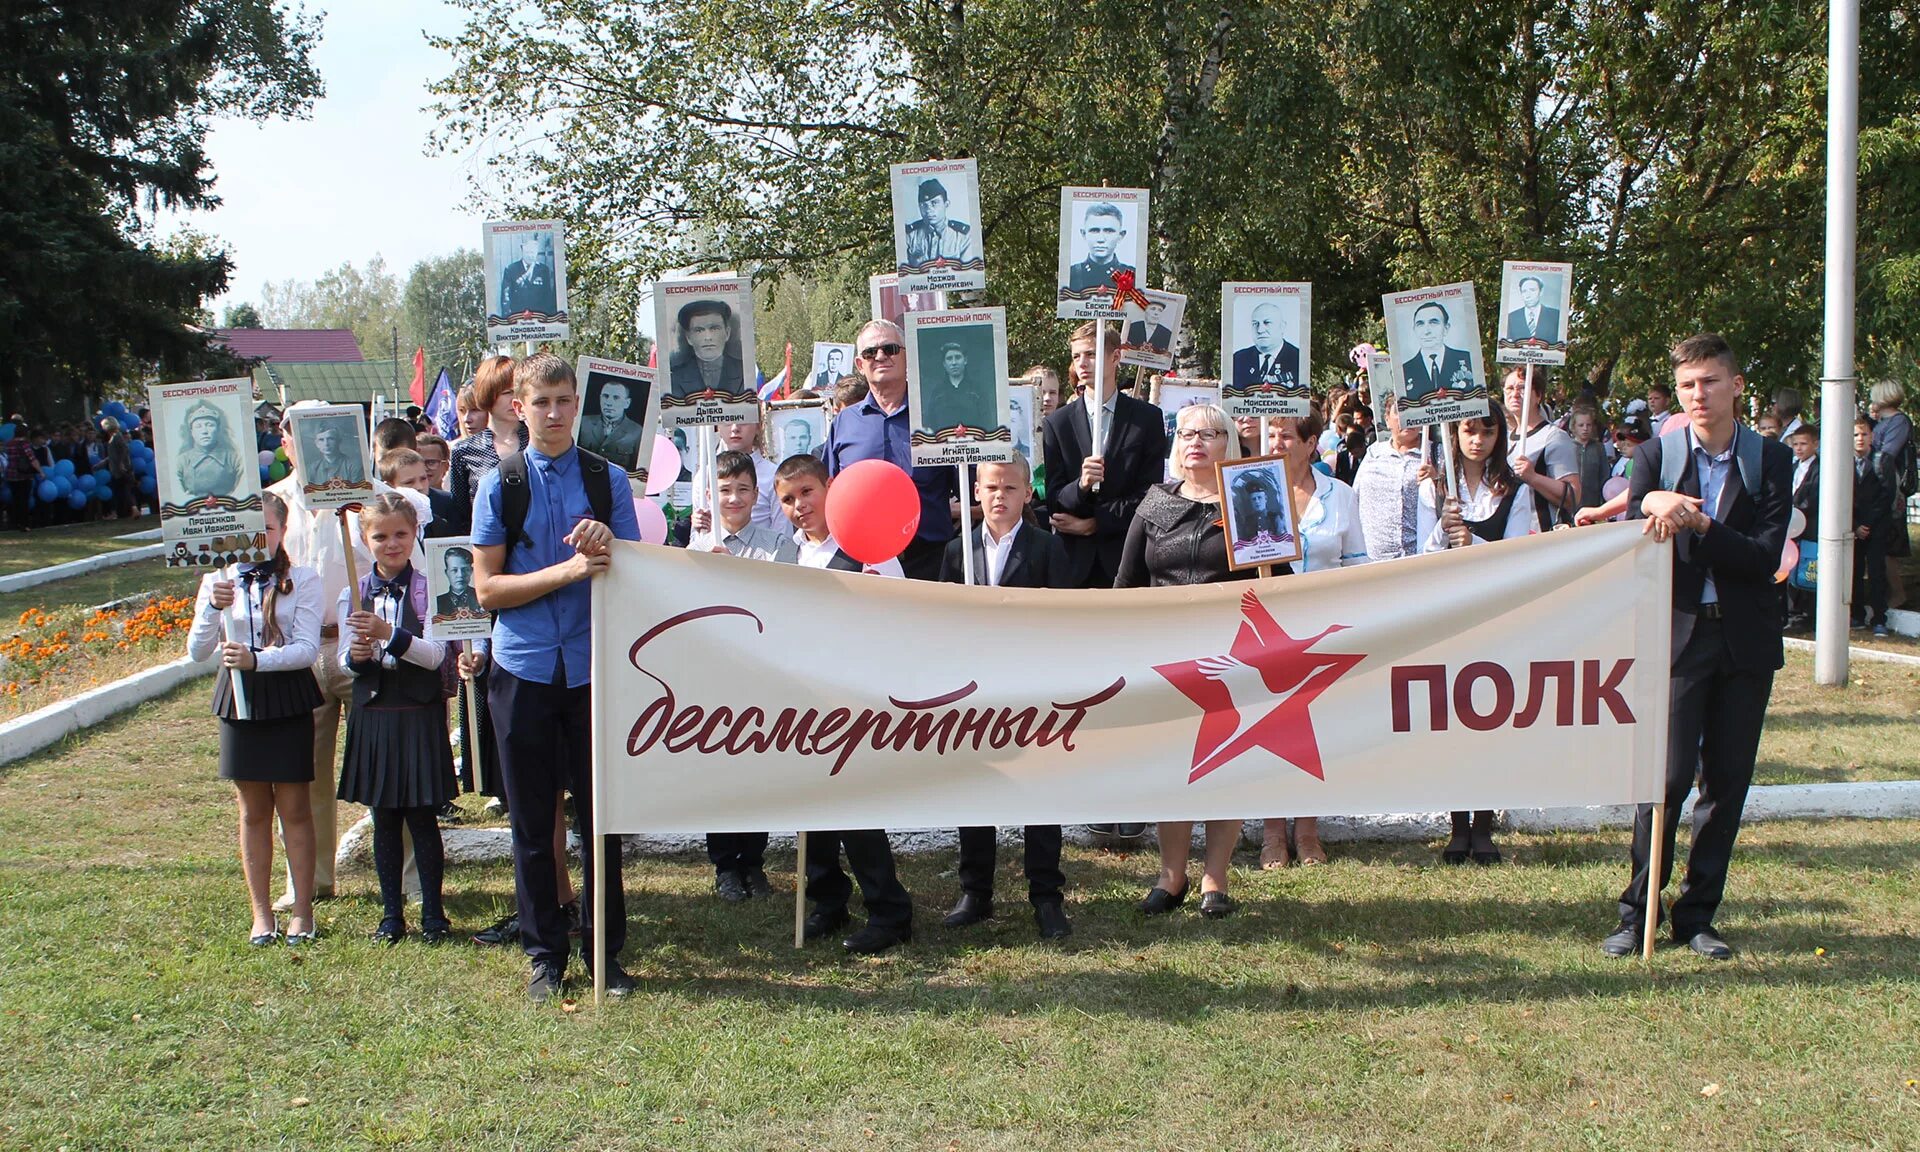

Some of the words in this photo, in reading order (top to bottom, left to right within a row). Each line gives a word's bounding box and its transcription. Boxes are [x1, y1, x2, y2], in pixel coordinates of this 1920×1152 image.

[665, 283, 719, 294] БЕССМЕРТНЫЙ
[720, 283, 739, 291] ПОЛК
[1394, 290, 1443, 304] БЕССМЕРТНЫЙ
[1444, 288, 1462, 296] ПОЛК
[917, 312, 972, 325] БЕССМЕРТНЫЙ
[972, 313, 992, 321] ПОЛК
[162, 384, 217, 398] БЕССМЕРТНЫЙ
[218, 384, 238, 392] ПОЛК
[626, 605, 1126, 776] бессмертный
[1391, 658, 1637, 733] ПОЛК
